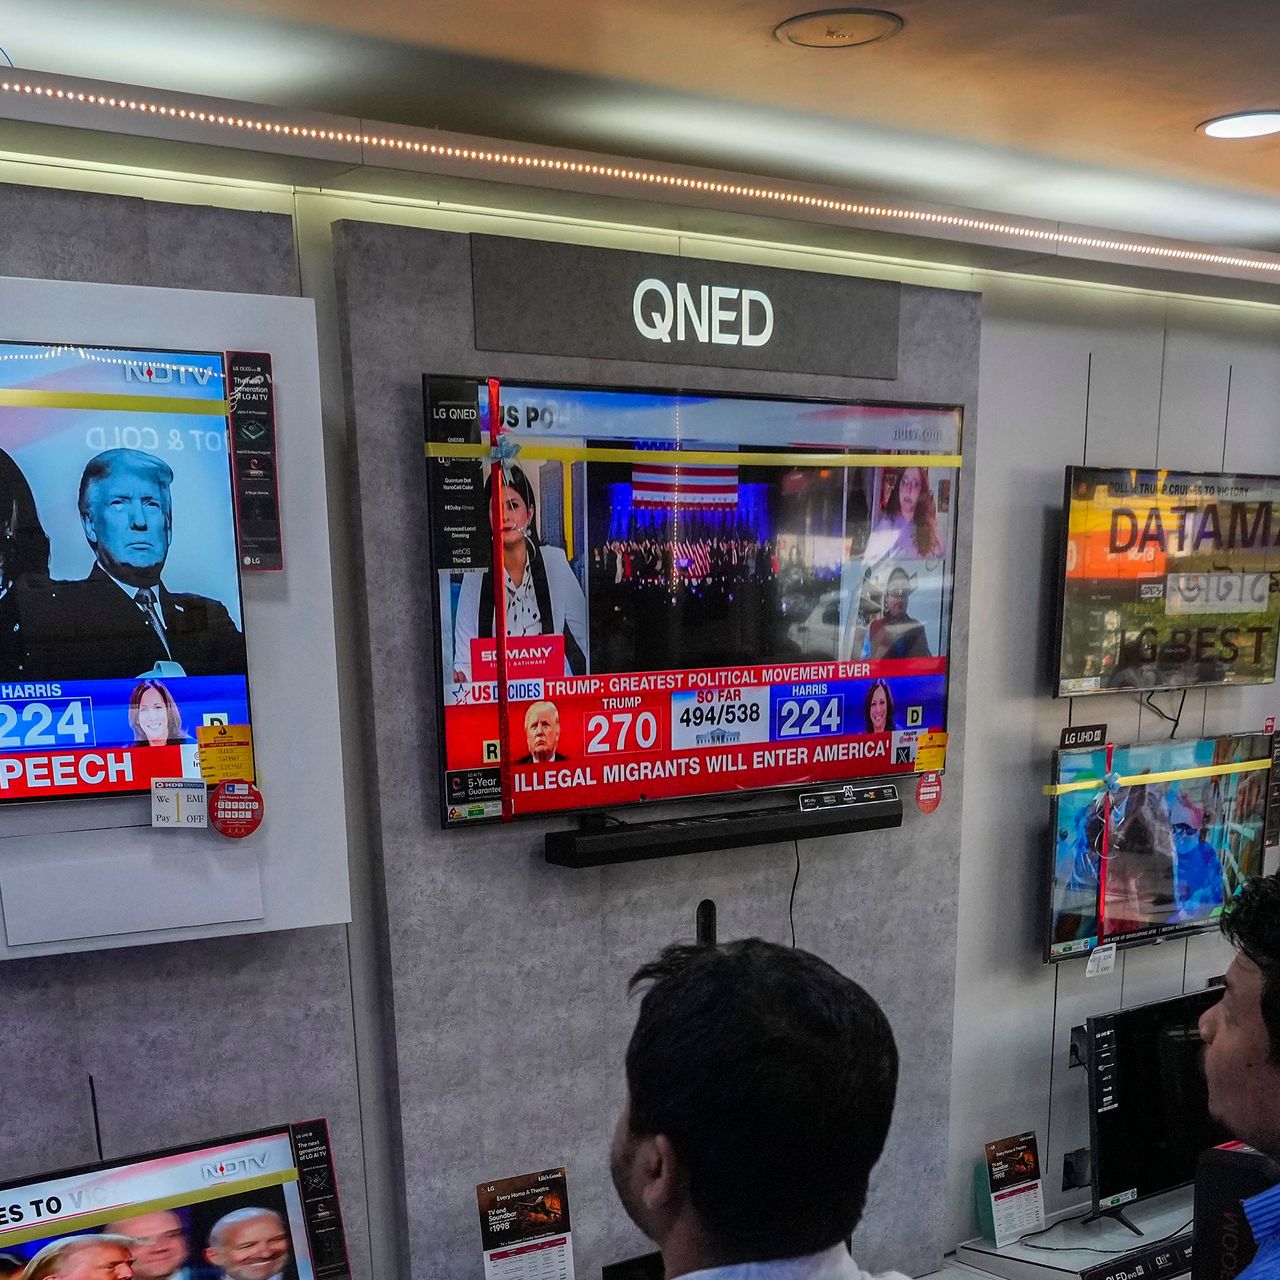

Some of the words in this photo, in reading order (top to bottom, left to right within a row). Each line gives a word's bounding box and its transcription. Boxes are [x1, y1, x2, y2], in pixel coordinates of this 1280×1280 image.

[632, 278, 774, 347] QNED
[123, 364, 213, 386] NDTV
[433, 407, 446, 419] LG
[449, 408, 477, 420] QNED
[472, 685, 491, 701] US
[493, 682, 541, 700] DCIDES
[546, 680, 605, 696] TRUMP:
[609, 673, 684, 692] GREATEST
[688, 669, 758, 687] POLITICAL
[761, 666, 835, 684] MOVEMENT
[838, 664, 870, 678] EVER
[792, 684, 828, 697] HARRIS
[1, 683, 62, 700] HARRIS
[697, 690, 715, 704] SO
[718, 688, 742, 702] FAR
[602, 697, 642, 710] TRUMP
[679, 702, 761, 728] 494/538
[781, 698, 842, 735] 224
[911, 710, 919, 723] D
[587, 712, 658, 753] 270
[486, 743, 498, 760] R
[514, 767, 597, 793] ILLEGAL
[602, 757, 700, 785] MIGRANTS
[705, 752, 748, 772] WILL
[752, 747, 809, 769] ENTER
[813, 739, 890, 763] AMERICA'
[468, 778, 497, 788] 5-Year
[156, 814, 170, 823] Pay
[187, 815, 204, 823] OFF
[202, 1151, 270, 1181] NDTV
[496, 1193, 510, 1202] Every
[511, 1191, 525, 1199] Home
[29, 1196, 63, 1219] TO
[488, 1211, 517, 1222] Soundbar
